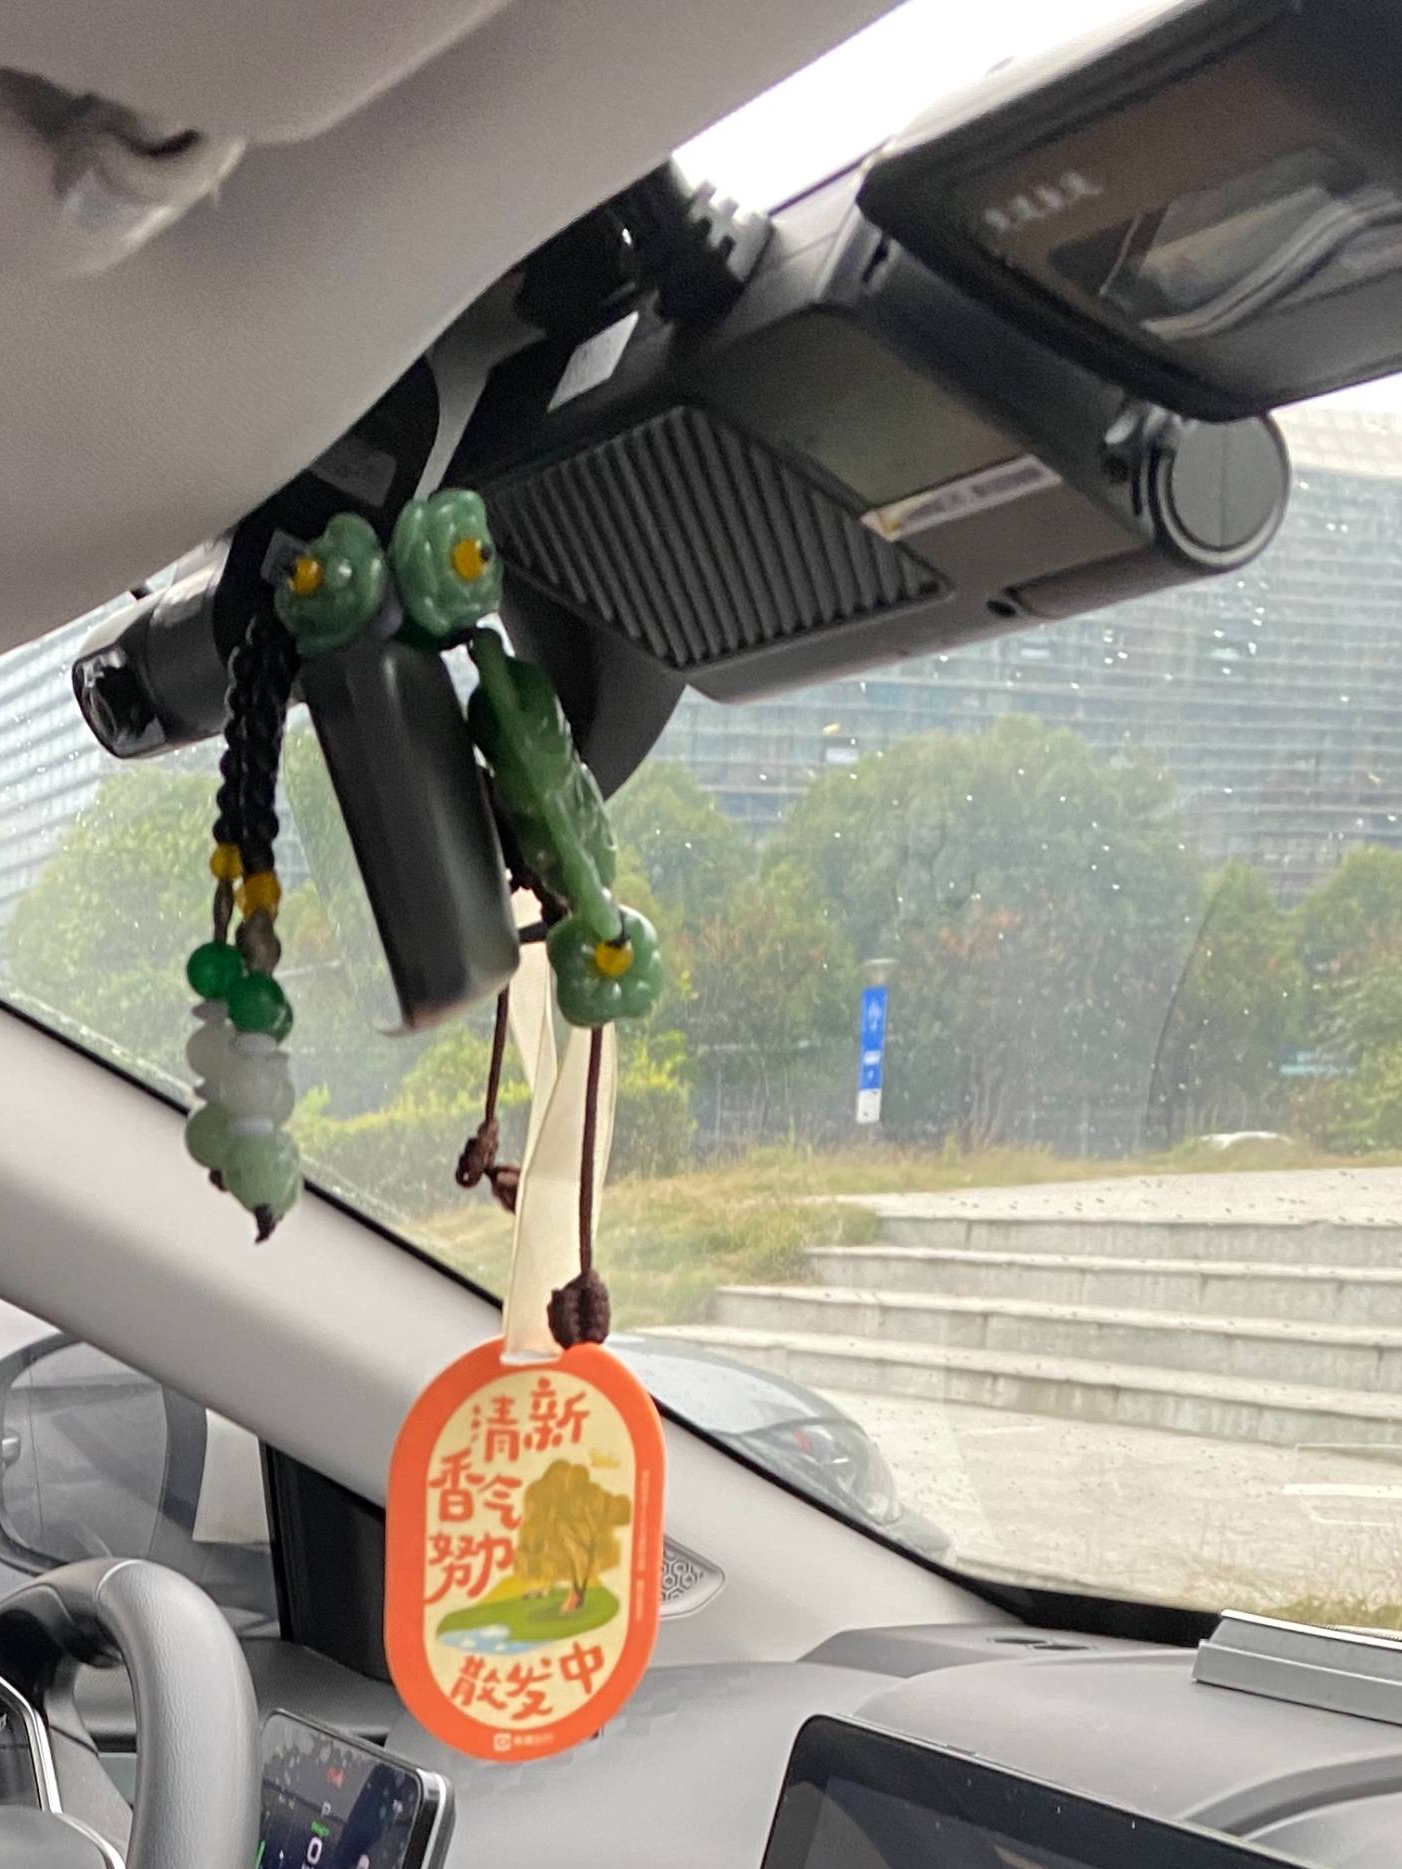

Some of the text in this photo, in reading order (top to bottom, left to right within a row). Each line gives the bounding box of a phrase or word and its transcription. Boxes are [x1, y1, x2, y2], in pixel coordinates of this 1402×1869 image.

[471, 1377, 589, 1464] 清新
[428, 1449, 524, 1530] 香气
[424, 1531, 516, 1607] 努力
[449, 1641, 606, 1721] 散发中
